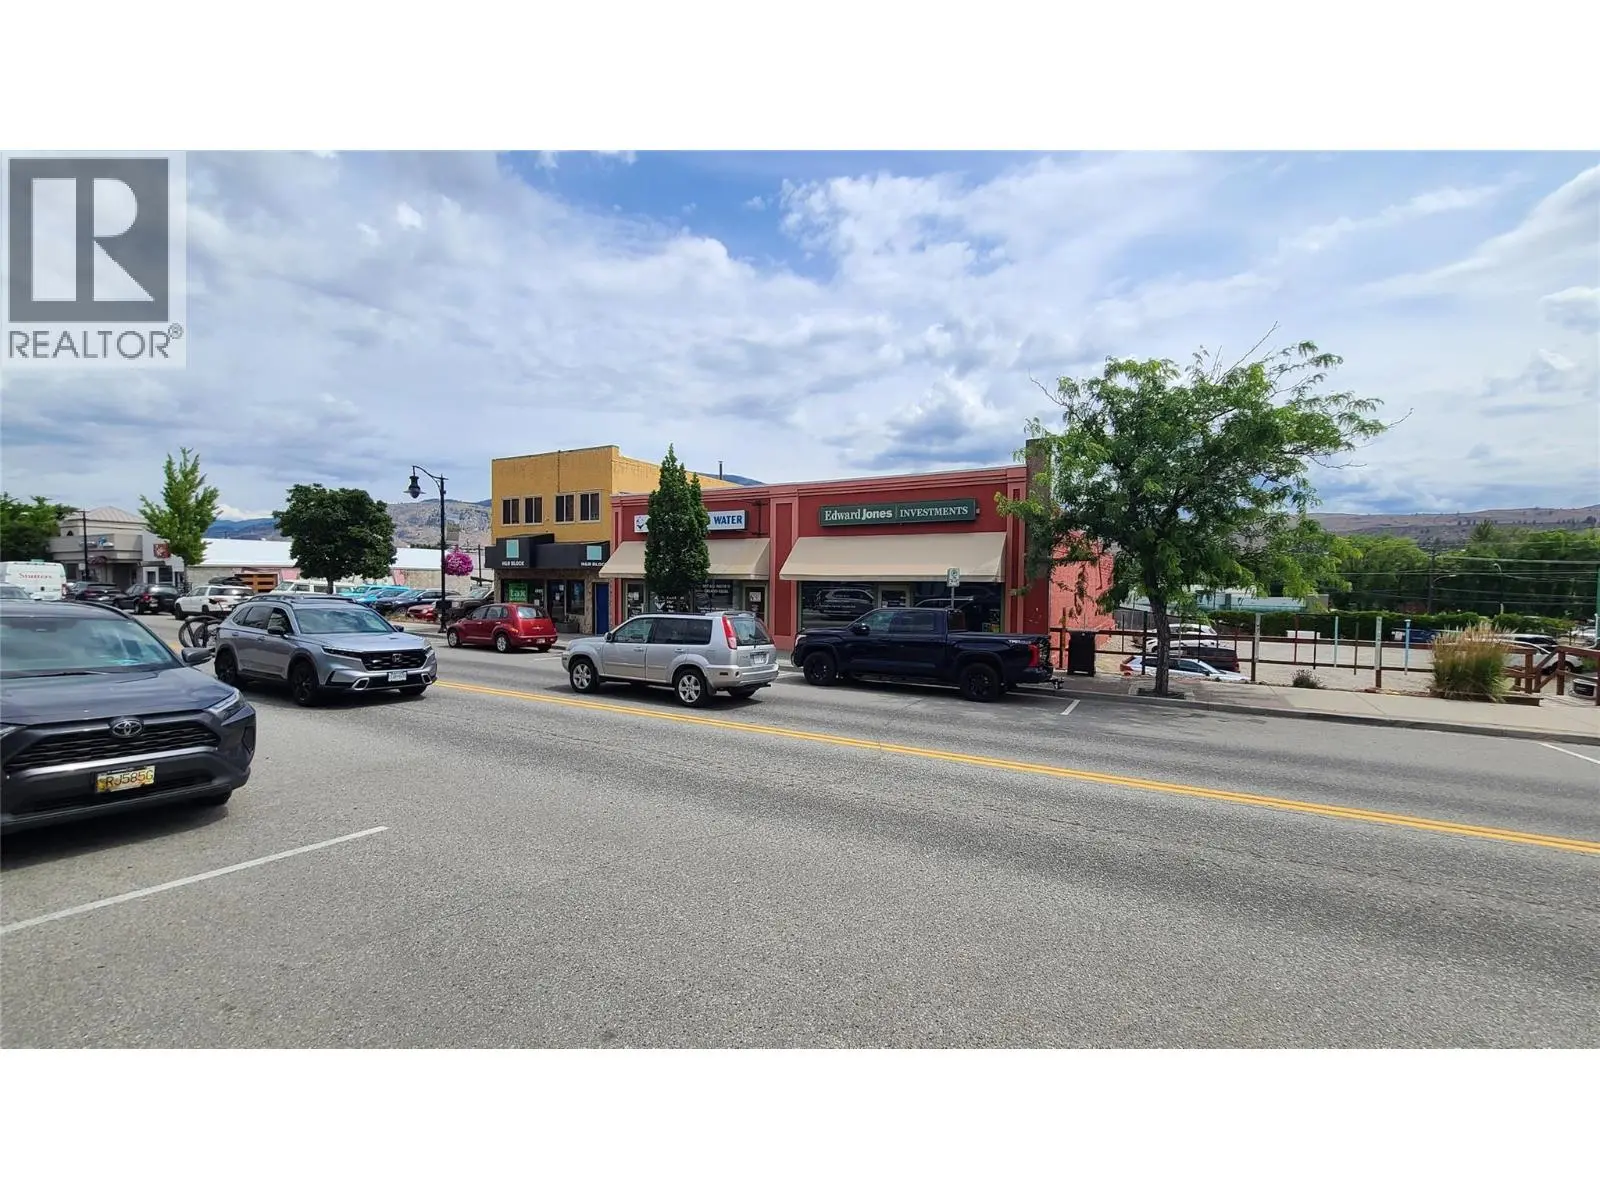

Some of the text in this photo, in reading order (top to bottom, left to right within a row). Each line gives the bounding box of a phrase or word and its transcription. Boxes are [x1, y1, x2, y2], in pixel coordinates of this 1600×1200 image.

[824, 506, 968, 521] Edward Jones INVESTMENTS
[713, 515, 743, 525] WATER
[510, 588, 527, 598] tax
